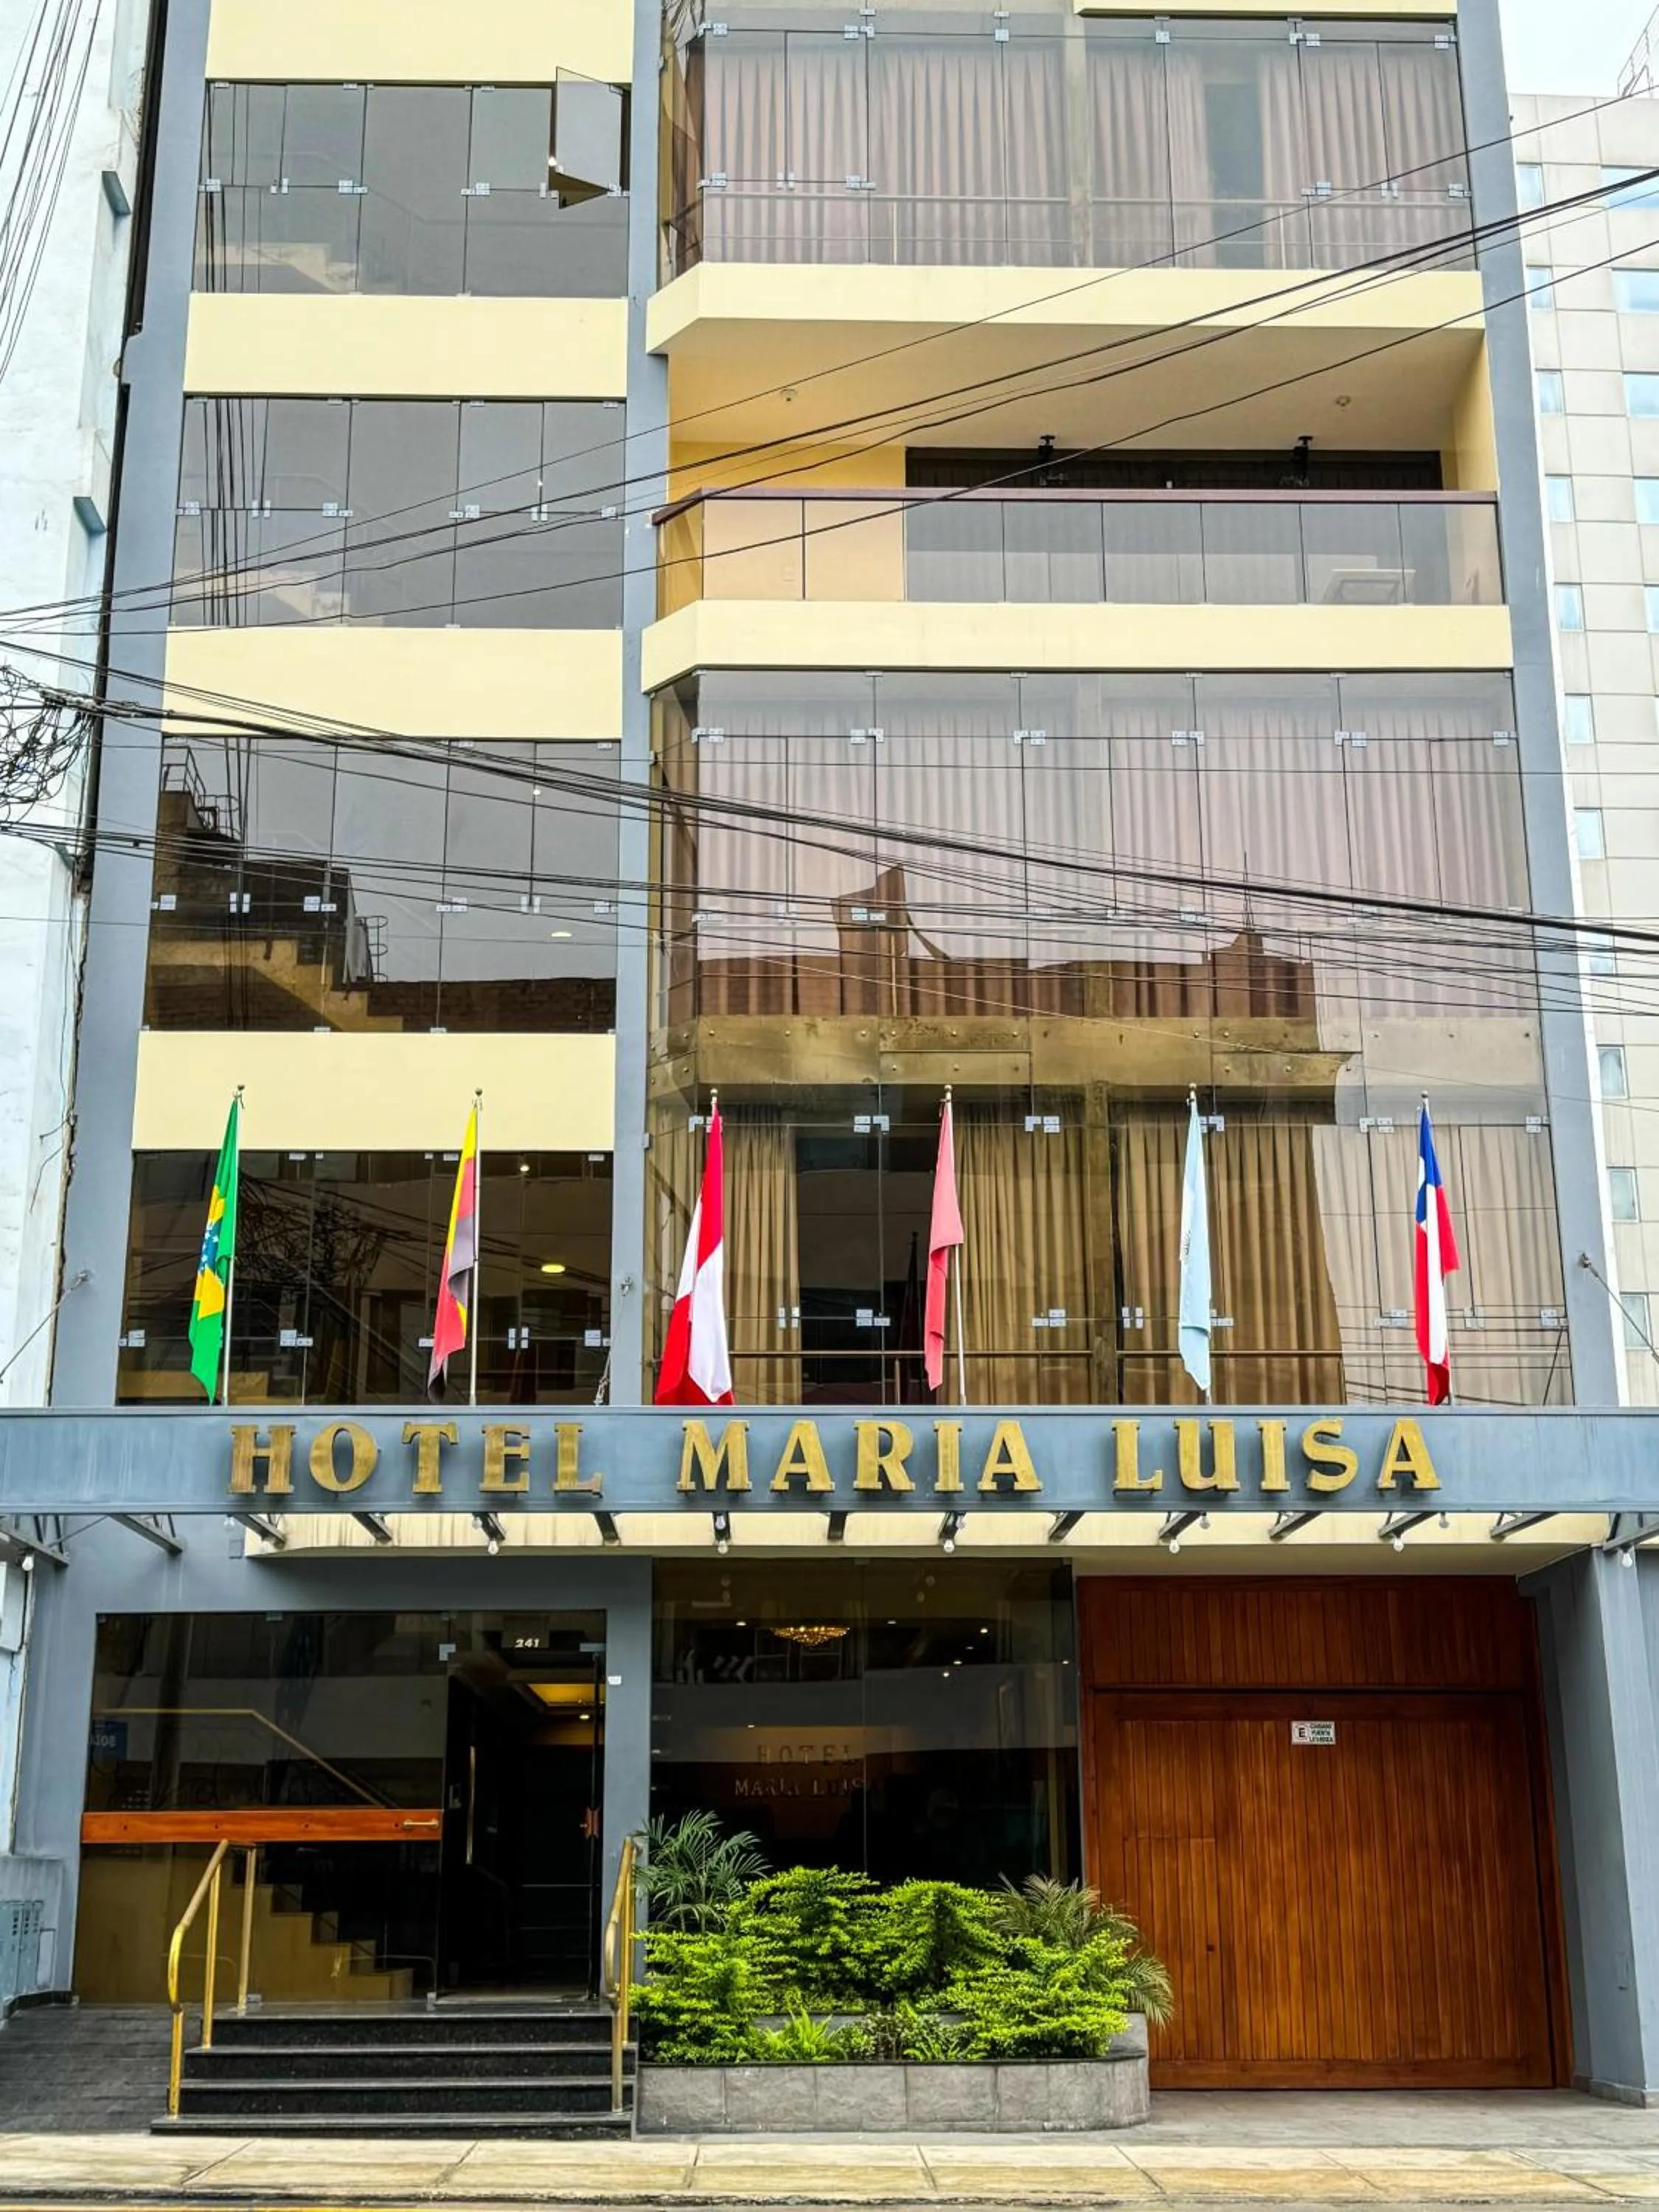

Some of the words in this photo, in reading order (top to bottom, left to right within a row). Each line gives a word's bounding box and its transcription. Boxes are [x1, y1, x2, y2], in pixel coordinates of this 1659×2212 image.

[228, 1420, 604, 1497] HOTEL
[676, 1419, 1043, 1493] MARIA
[1111, 1418, 1441, 1492] LUISA
[515, 1638, 539, 1648] 241
[757, 1745, 860, 1765] HOTEL
[734, 1778, 801, 1796] MARIA
